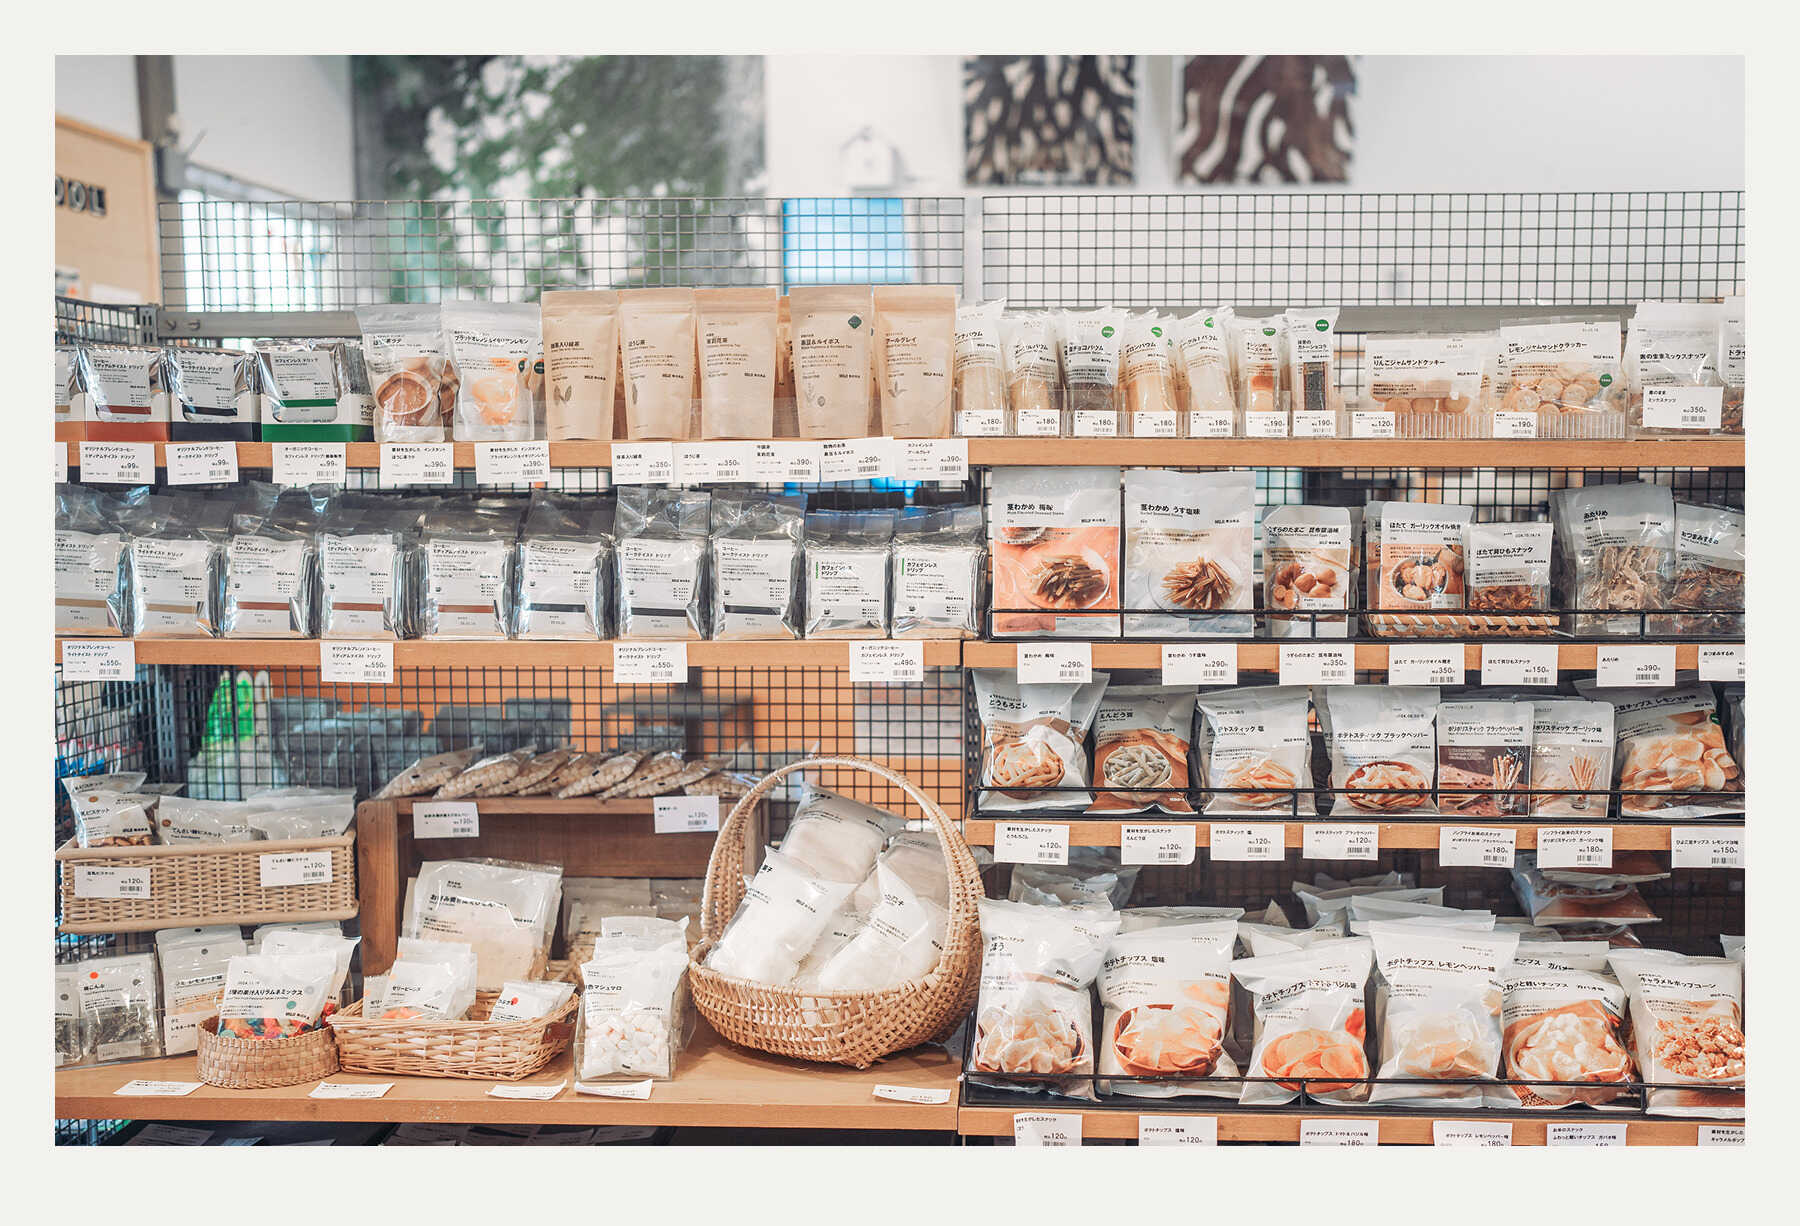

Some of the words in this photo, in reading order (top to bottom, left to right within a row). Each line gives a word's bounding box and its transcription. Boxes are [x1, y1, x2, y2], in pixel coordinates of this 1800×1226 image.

[1007, 503, 1034, 511] 茎わかめ
[1140, 503, 1169, 511] 茎わかめ
[1173, 506, 1200, 515] うす塩味
